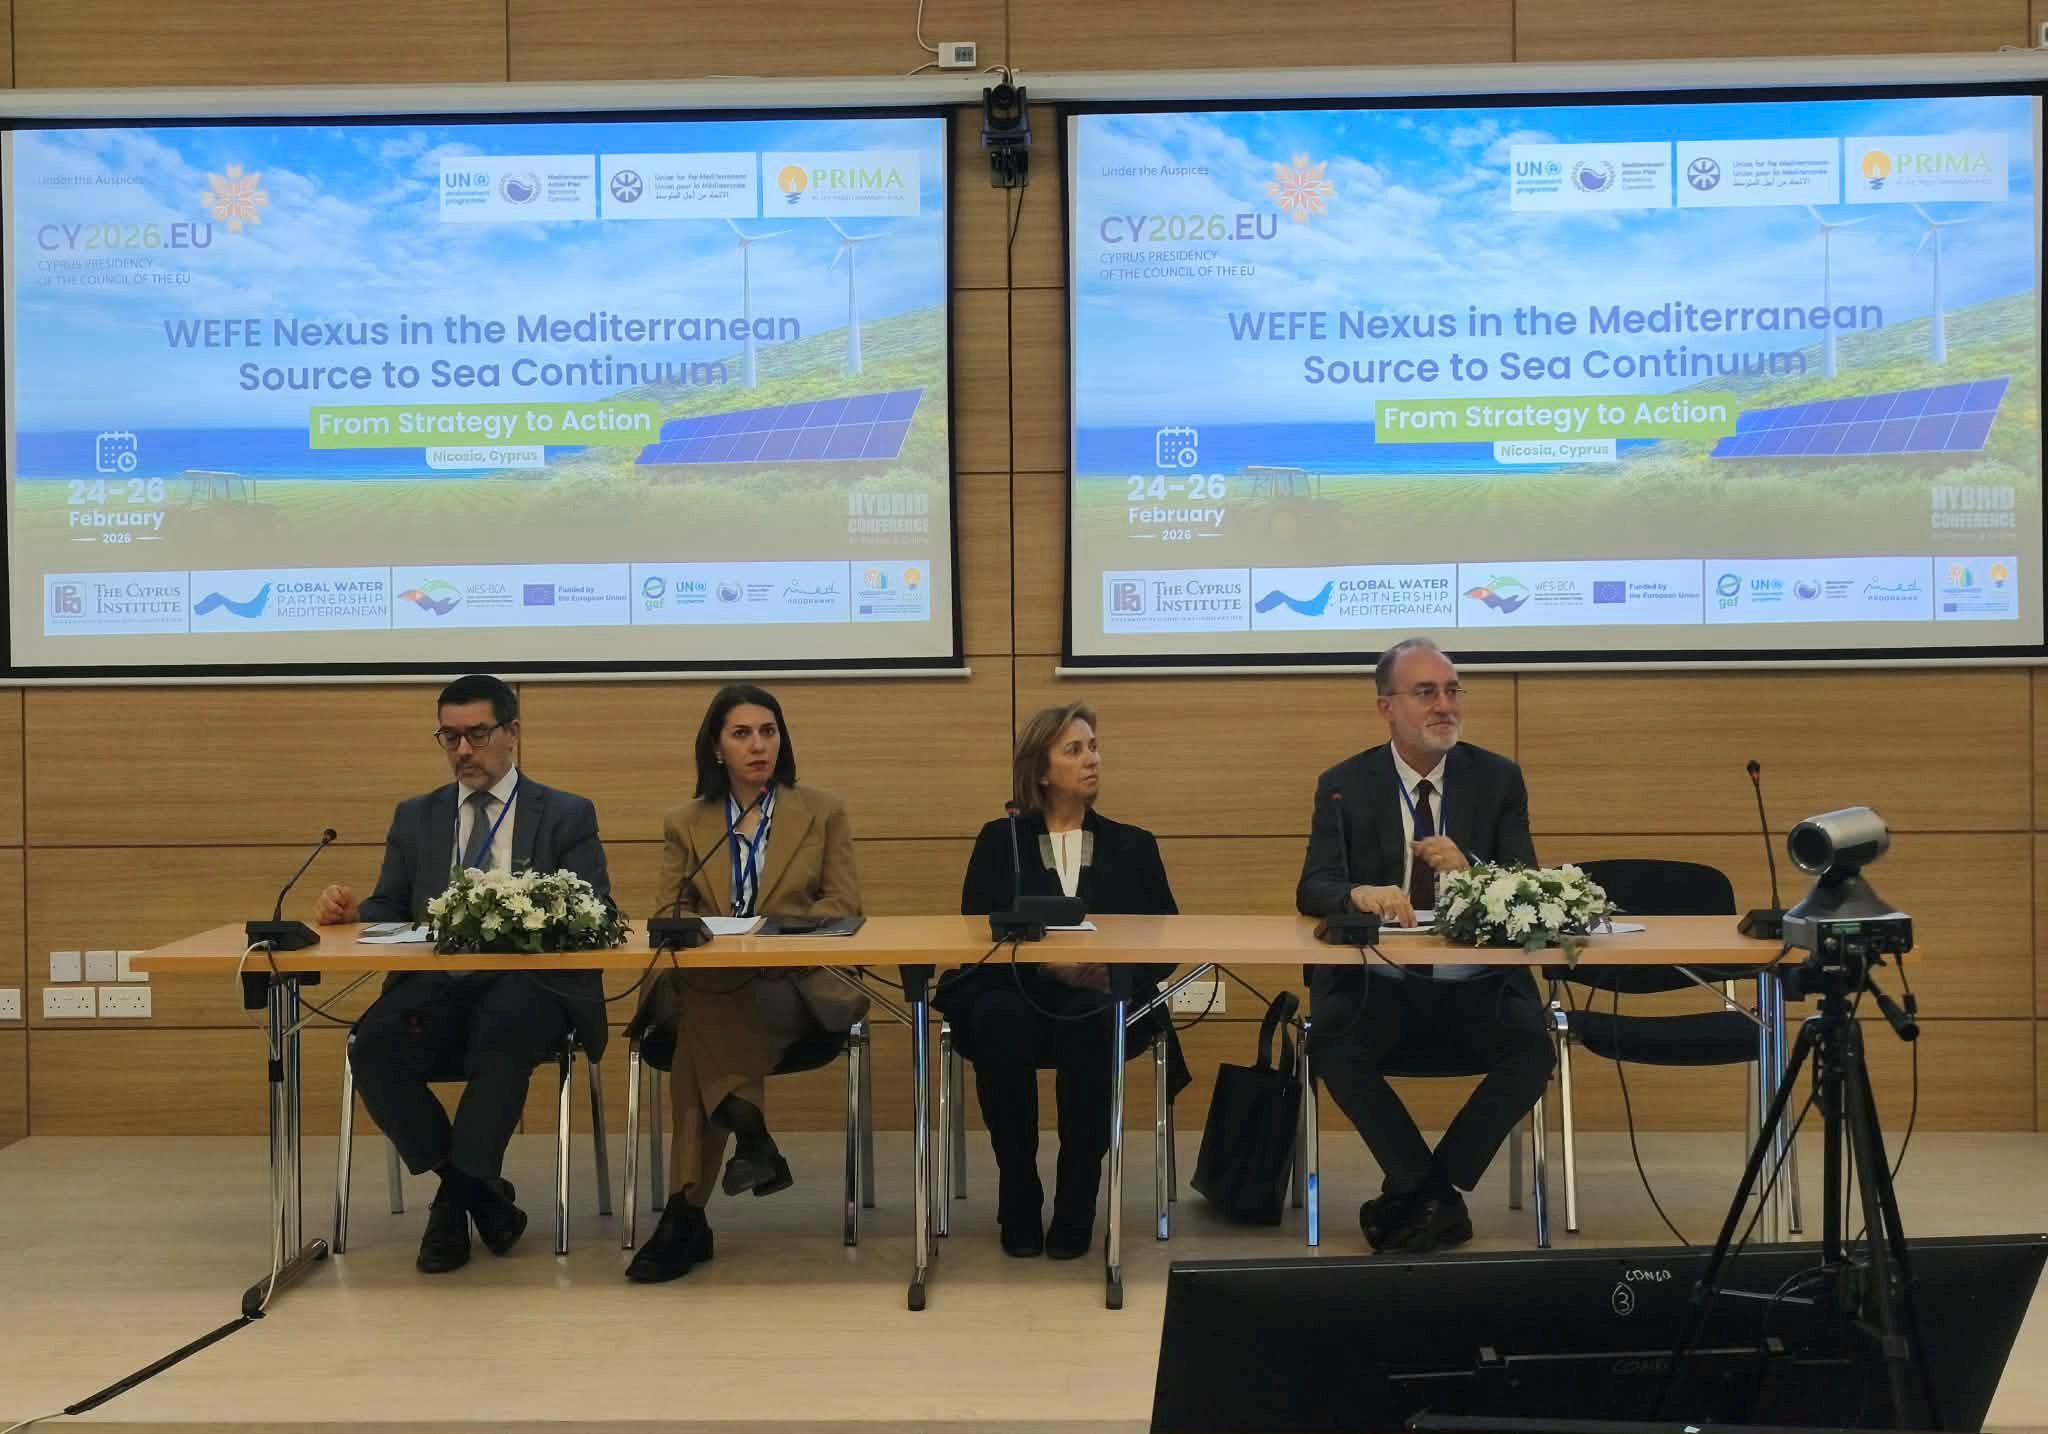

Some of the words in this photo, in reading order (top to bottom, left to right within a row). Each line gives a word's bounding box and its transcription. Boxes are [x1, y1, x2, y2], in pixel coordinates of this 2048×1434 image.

[1897, 152, 1992, 174] PRIMA
[812, 167, 904, 189] PRIMA
[38, 222, 212, 250] CY2026.EU
[1100, 213, 1278, 243] CY2026.EU
[1100, 251, 1145, 264] CYPRUS
[1148, 250, 1218, 262] PRESIDENCY
[1119, 268, 1141, 279] THE
[1143, 266, 1195, 278] COUNCIL
[1197, 266, 1213, 277] OF
[1215, 265, 1237, 277] THE
[1240, 265, 1255, 276] EU
[1229, 311, 1328, 340] WEFE
[1339, 310, 1457, 340] Nexus
[1468, 305, 1501, 337] in
[1514, 304, 1577, 337] the
[1589, 301, 1883, 335] Mediterranean
[166, 319, 262, 348] WEFE
[273, 318, 389, 346] Nexus
[400, 313, 433, 345] in
[445, 313, 506, 344] the
[517, 311, 799, 343] Mediterranean
[239, 361, 372, 390] Source
[382, 361, 420, 389] to
[431, 359, 501, 388] Sea
[512, 355, 728, 386] Continuum
[1304, 355, 1440, 384] Source
[1450, 353, 1489, 381] to
[1500, 351, 1571, 381] Sea
[1583, 345, 1807, 379] Continuum
[319, 413, 390, 436] From
[400, 410, 518, 438] Strategy
[525, 410, 553, 432] to
[562, 408, 650, 432] Action
[1384, 407, 1457, 430] From
[1465, 404, 1589, 433] Strategy
[1599, 403, 1625, 425] to
[1634, 400, 1727, 425] Action
[489, 449, 537, 463] Cyprus
[1501, 444, 1556, 459] Nicosia,
[1559, 443, 1608, 457] Cyprus
[70, 509, 165, 530] February
[1129, 506, 1225, 528] February
[103, 533, 131, 544] 2026
[1162, 530, 1192, 541] 2026
[126, 582, 181, 598] CYPRUS
[277, 583, 330, 593] GLOBAL
[334, 581, 384, 591] WATER
[1152, 580, 1184, 596] THE
[1186, 580, 1241, 596] CYPRUS
[1339, 580, 1394, 591] GLOBAL
[1399, 579, 1449, 589] WATER
[277, 593, 384, 605] PARTNERSHIP
[1156, 596, 1242, 612] INSTITUTE
[1339, 591, 1449, 603] PARTNERSHIP
[96, 598, 181, 614] INSTITUTE
[277, 605, 387, 617] MEDITERRANEAN
[1339, 603, 1451, 616] MEDITERRANEAN
